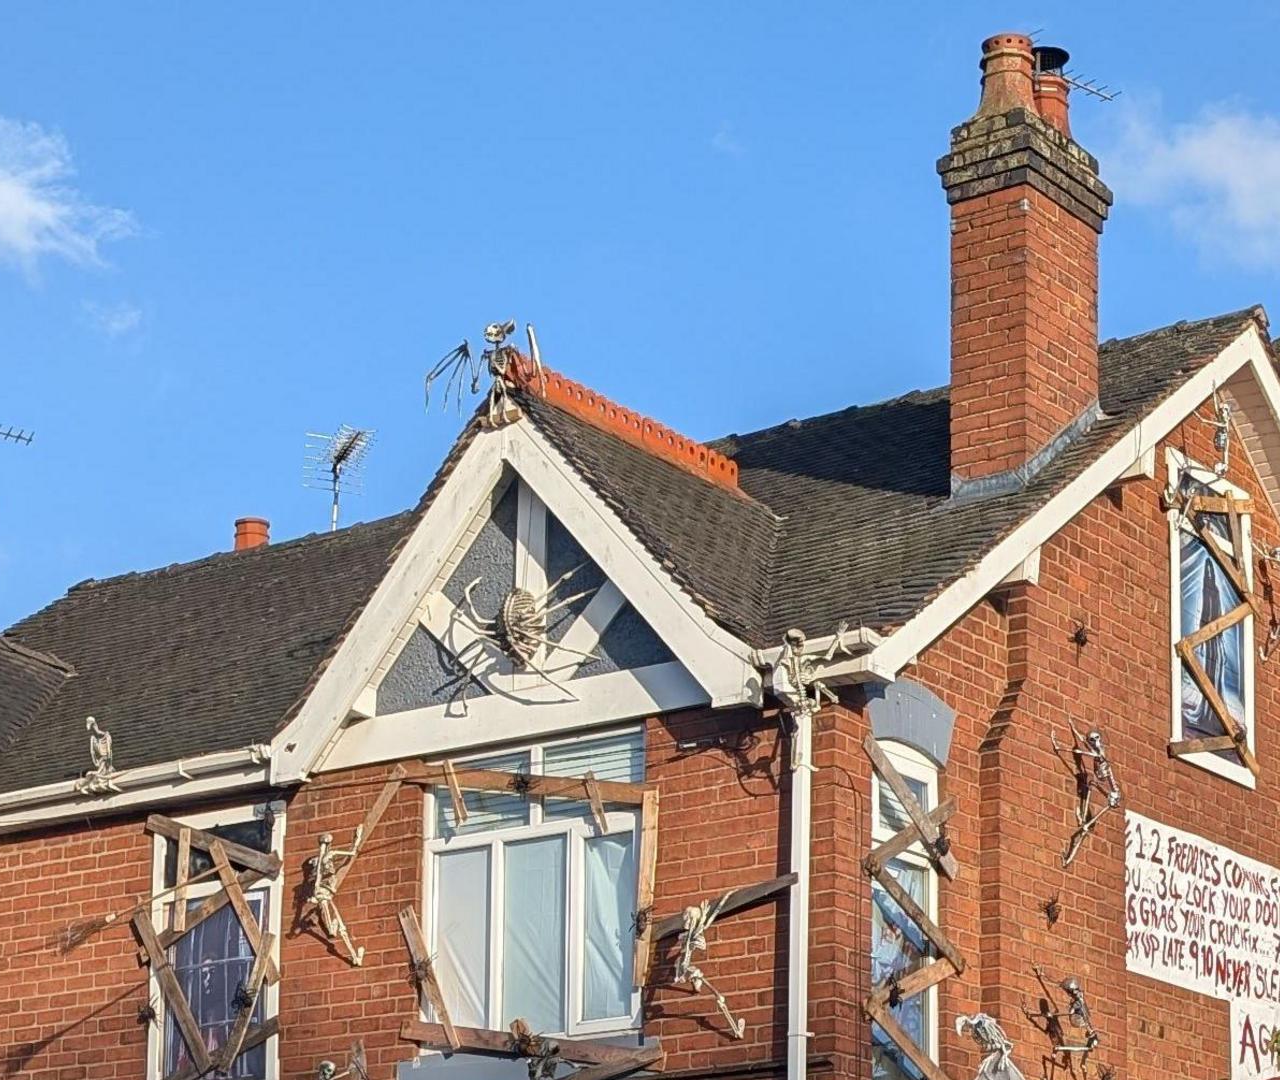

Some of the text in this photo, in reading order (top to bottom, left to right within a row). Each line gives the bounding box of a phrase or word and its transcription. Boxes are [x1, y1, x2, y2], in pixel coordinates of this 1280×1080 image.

[1186, 880, 1217, 914] LOCK
[1222, 890, 1250, 923] YOUR
[1223, 859, 1270, 900] COMING
[1140, 896, 1177, 933] GRAB
[1180, 908, 1206, 941] YOUR
[1141, 932, 1160, 968] UP
[1215, 951, 1251, 997] NEVER
